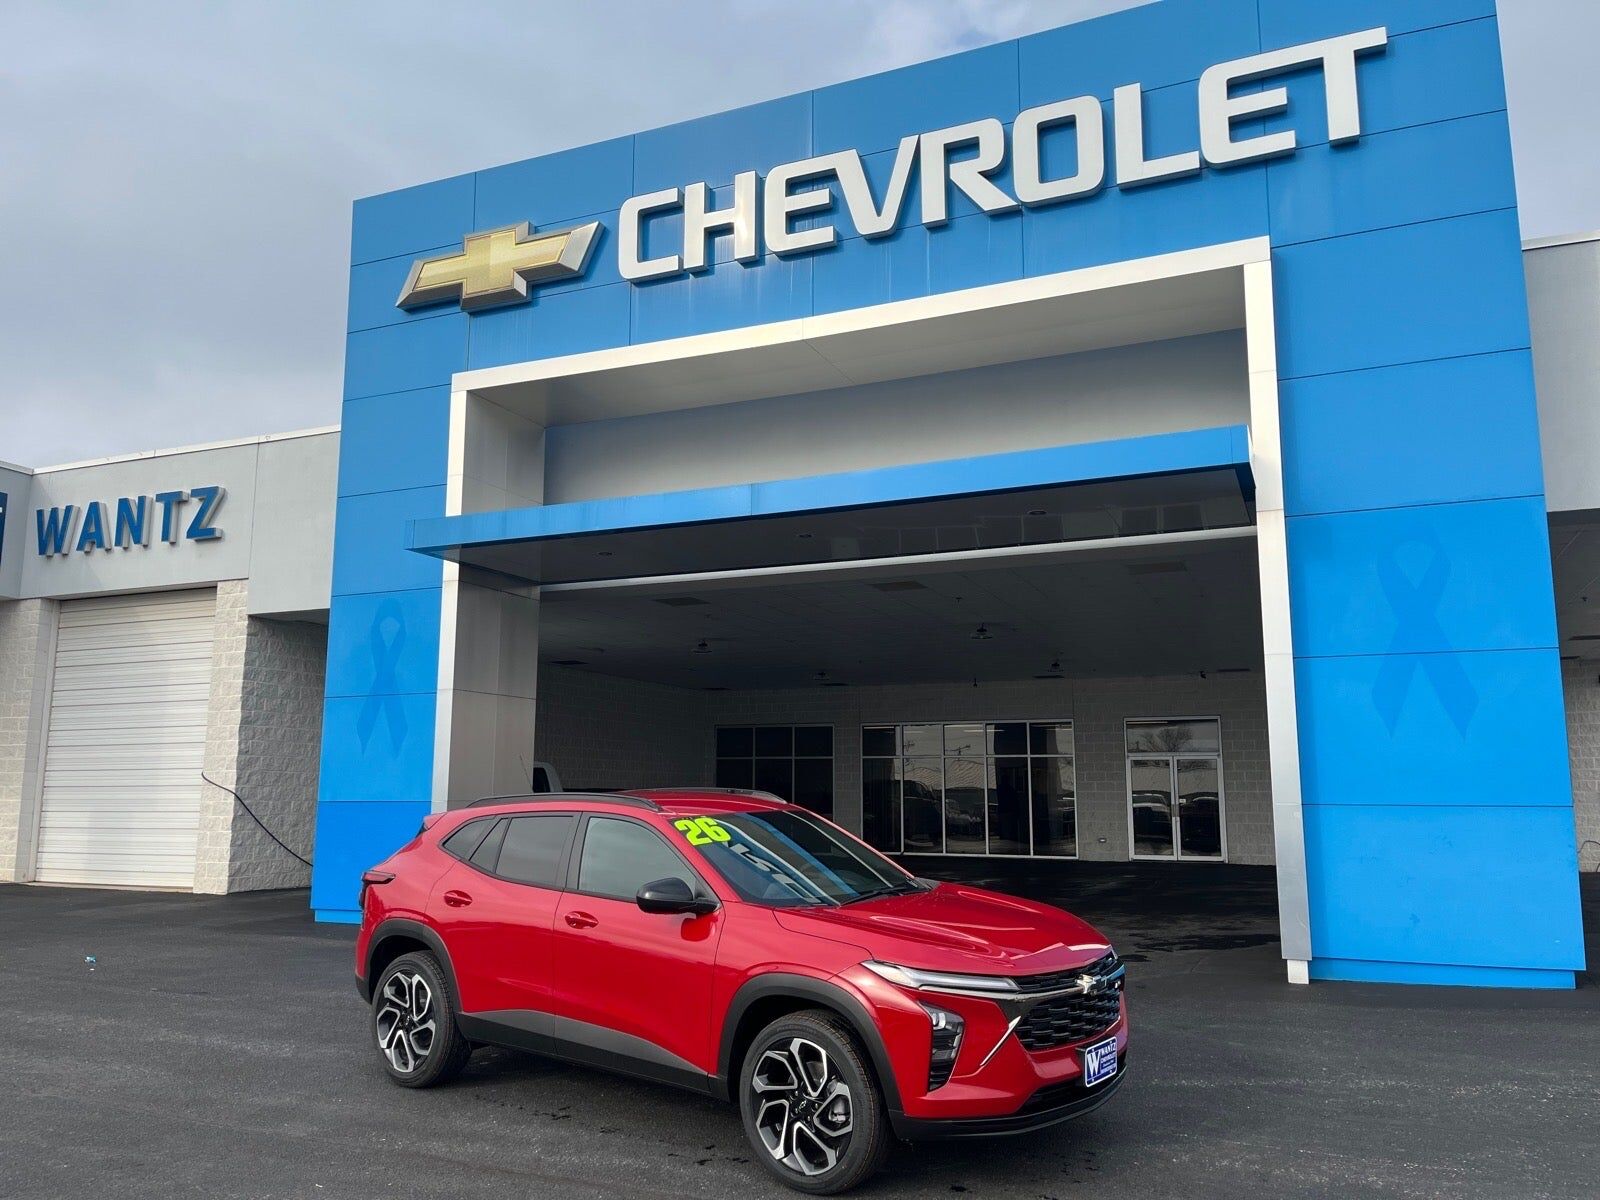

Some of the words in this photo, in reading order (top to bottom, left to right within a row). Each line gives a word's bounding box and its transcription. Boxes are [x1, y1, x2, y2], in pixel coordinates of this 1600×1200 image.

[618, 27, 1388, 284] CHEVROLET
[36, 486, 224, 557] WANTZ
[674, 817, 732, 846] 26
